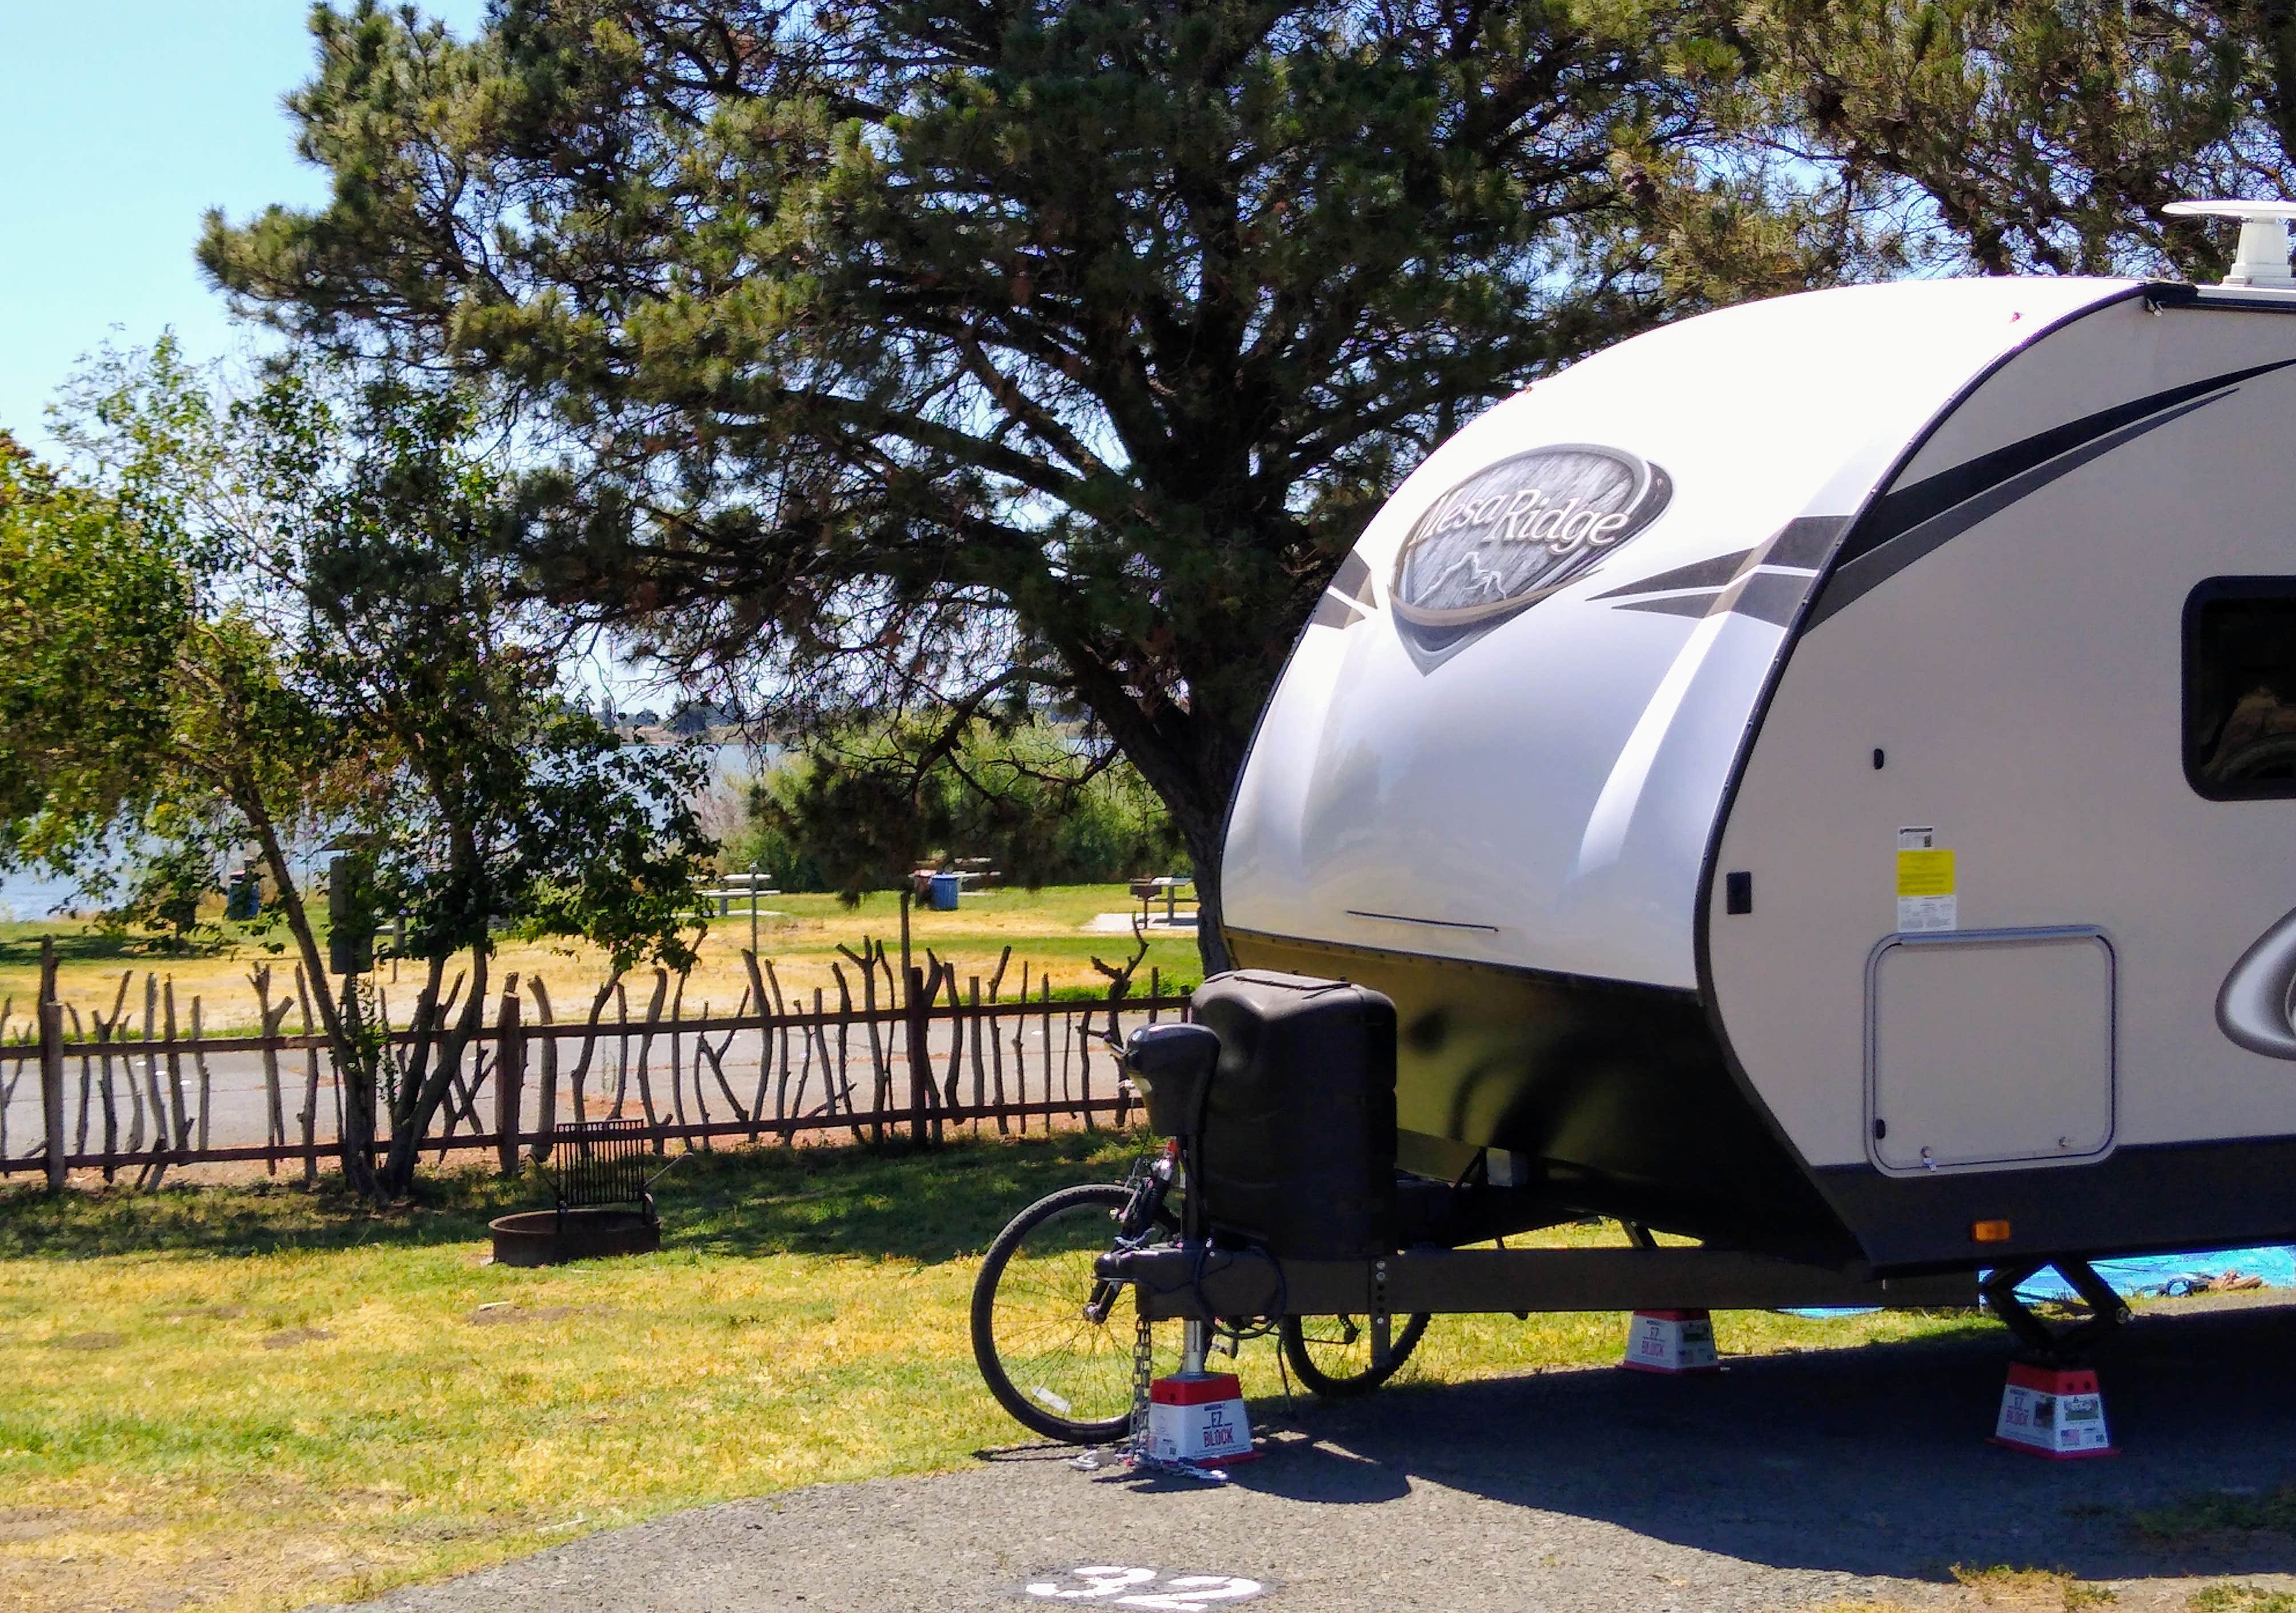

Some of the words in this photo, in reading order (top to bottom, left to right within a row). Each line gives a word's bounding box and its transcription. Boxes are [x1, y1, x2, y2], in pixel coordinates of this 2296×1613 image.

[1409, 487, 1509, 546] Mesa
[1482, 489, 1629, 555] Ridge
[1211, 1411, 1223, 1428] EZ
[1203, 1428, 1234, 1448] BLOCK
[1025, 1566, 1262, 1612] 32
